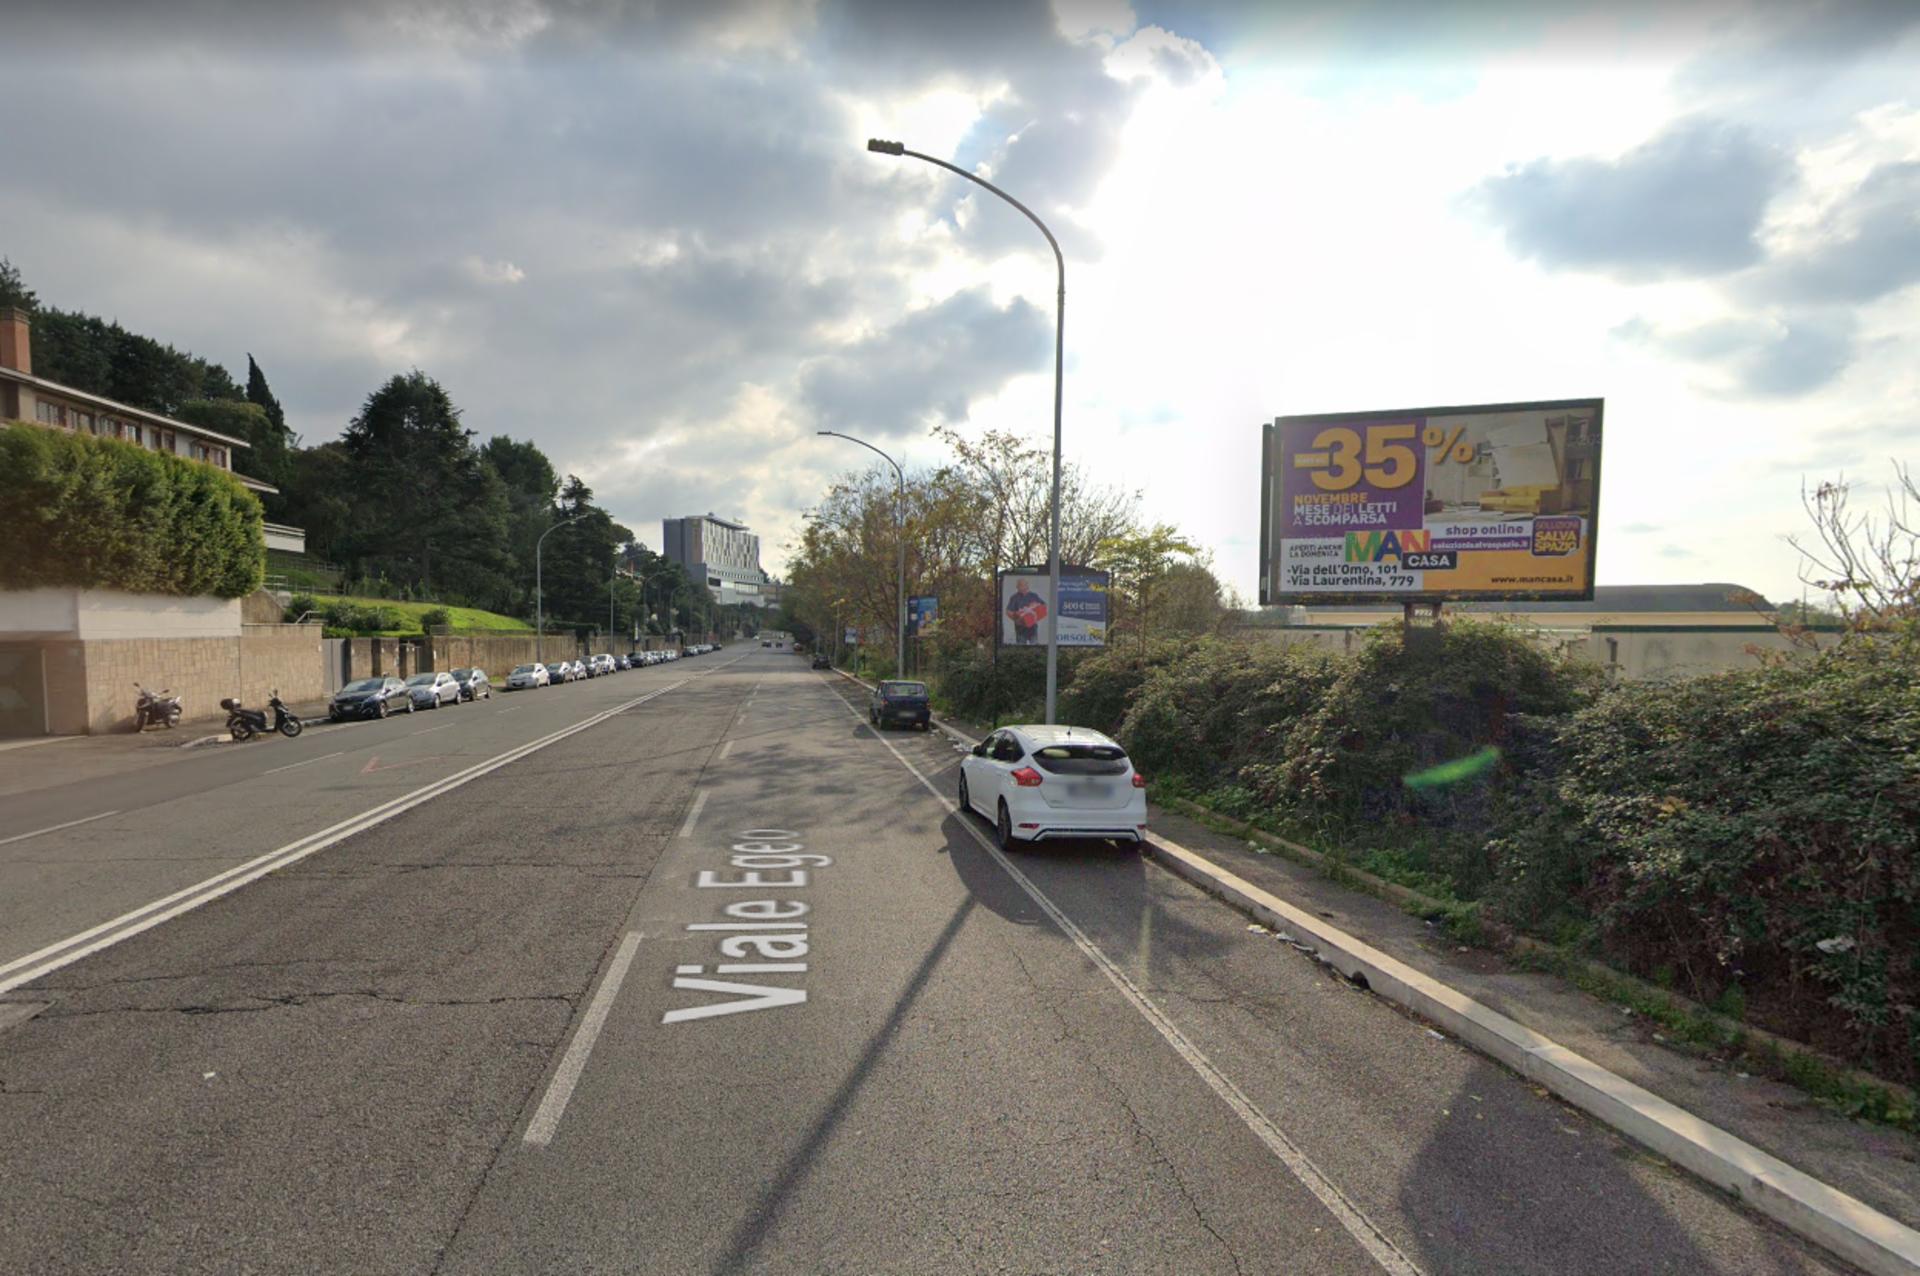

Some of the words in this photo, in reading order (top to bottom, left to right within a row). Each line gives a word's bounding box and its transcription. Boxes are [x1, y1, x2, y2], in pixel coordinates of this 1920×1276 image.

[1294, 492, 1368, 505] NOVEMBRE
[1294, 504, 1330, 515] MESE
[1333, 503, 1355, 514] DEI
[1358, 501, 1397, 514] LETTI
[1293, 516, 1302, 526] A
[1304, 513, 1387, 526] SCOMPARSA
[1535, 520, 1579, 530] SOLUZIONI
[1446, 524, 1478, 539] shop
[1481, 522, 1524, 535] online
[1535, 530, 1577, 541] SALVA
[1345, 530, 1430, 562] MAN
[1535, 540, 1577, 552] SPAZIO
[1408, 554, 1450, 567] CASA
[1378, 564, 1398, 574] 101
[1313, 574, 1386, 587] Laurentina,
[1389, 575, 1414, 587] 779
[1491, 575, 1574, 584] www.mancasa.it
